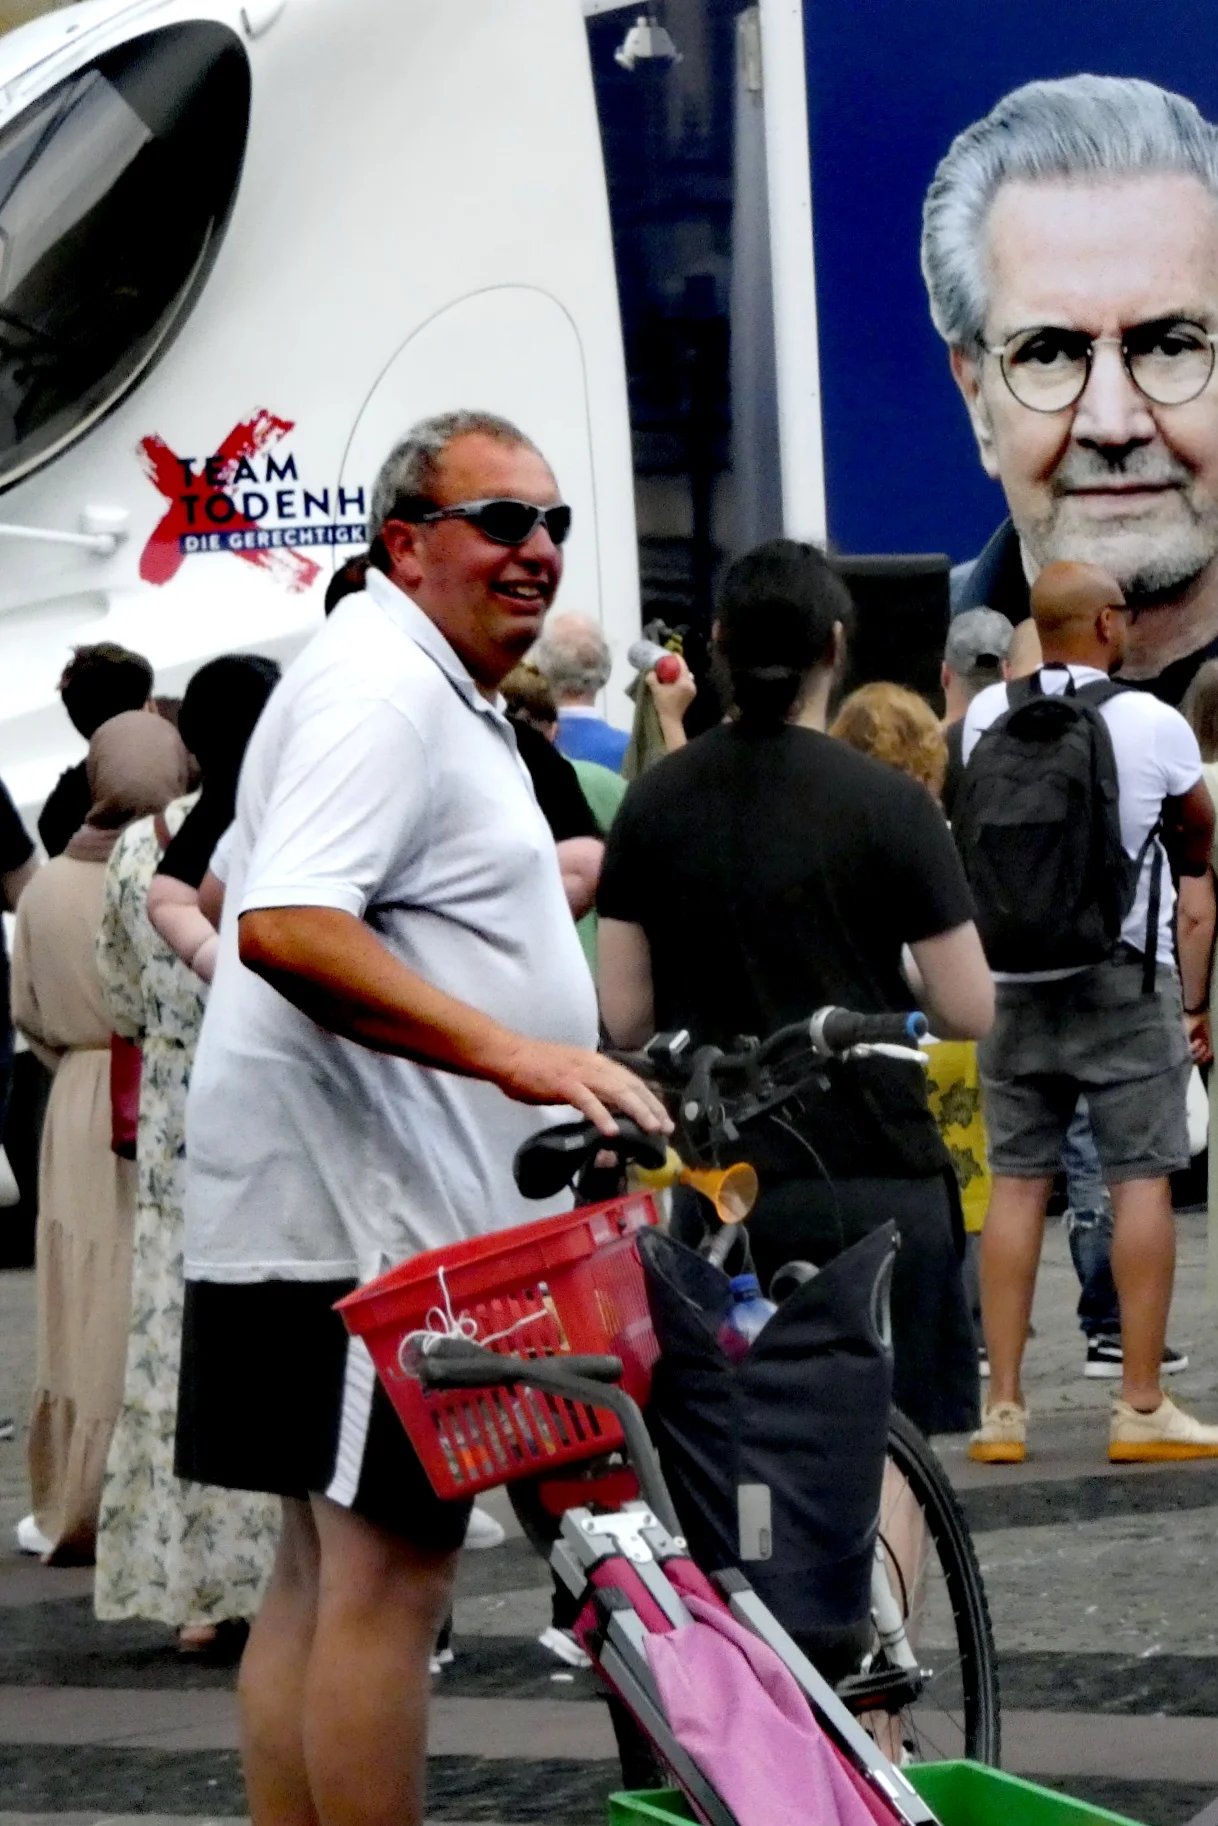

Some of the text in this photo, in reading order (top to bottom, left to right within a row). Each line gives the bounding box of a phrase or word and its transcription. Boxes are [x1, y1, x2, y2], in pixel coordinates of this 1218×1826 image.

[176, 452, 298, 487] TEAM
[180, 486, 365, 525] TODENH
[182, 525, 365, 552] DIE GERECHTIGK
